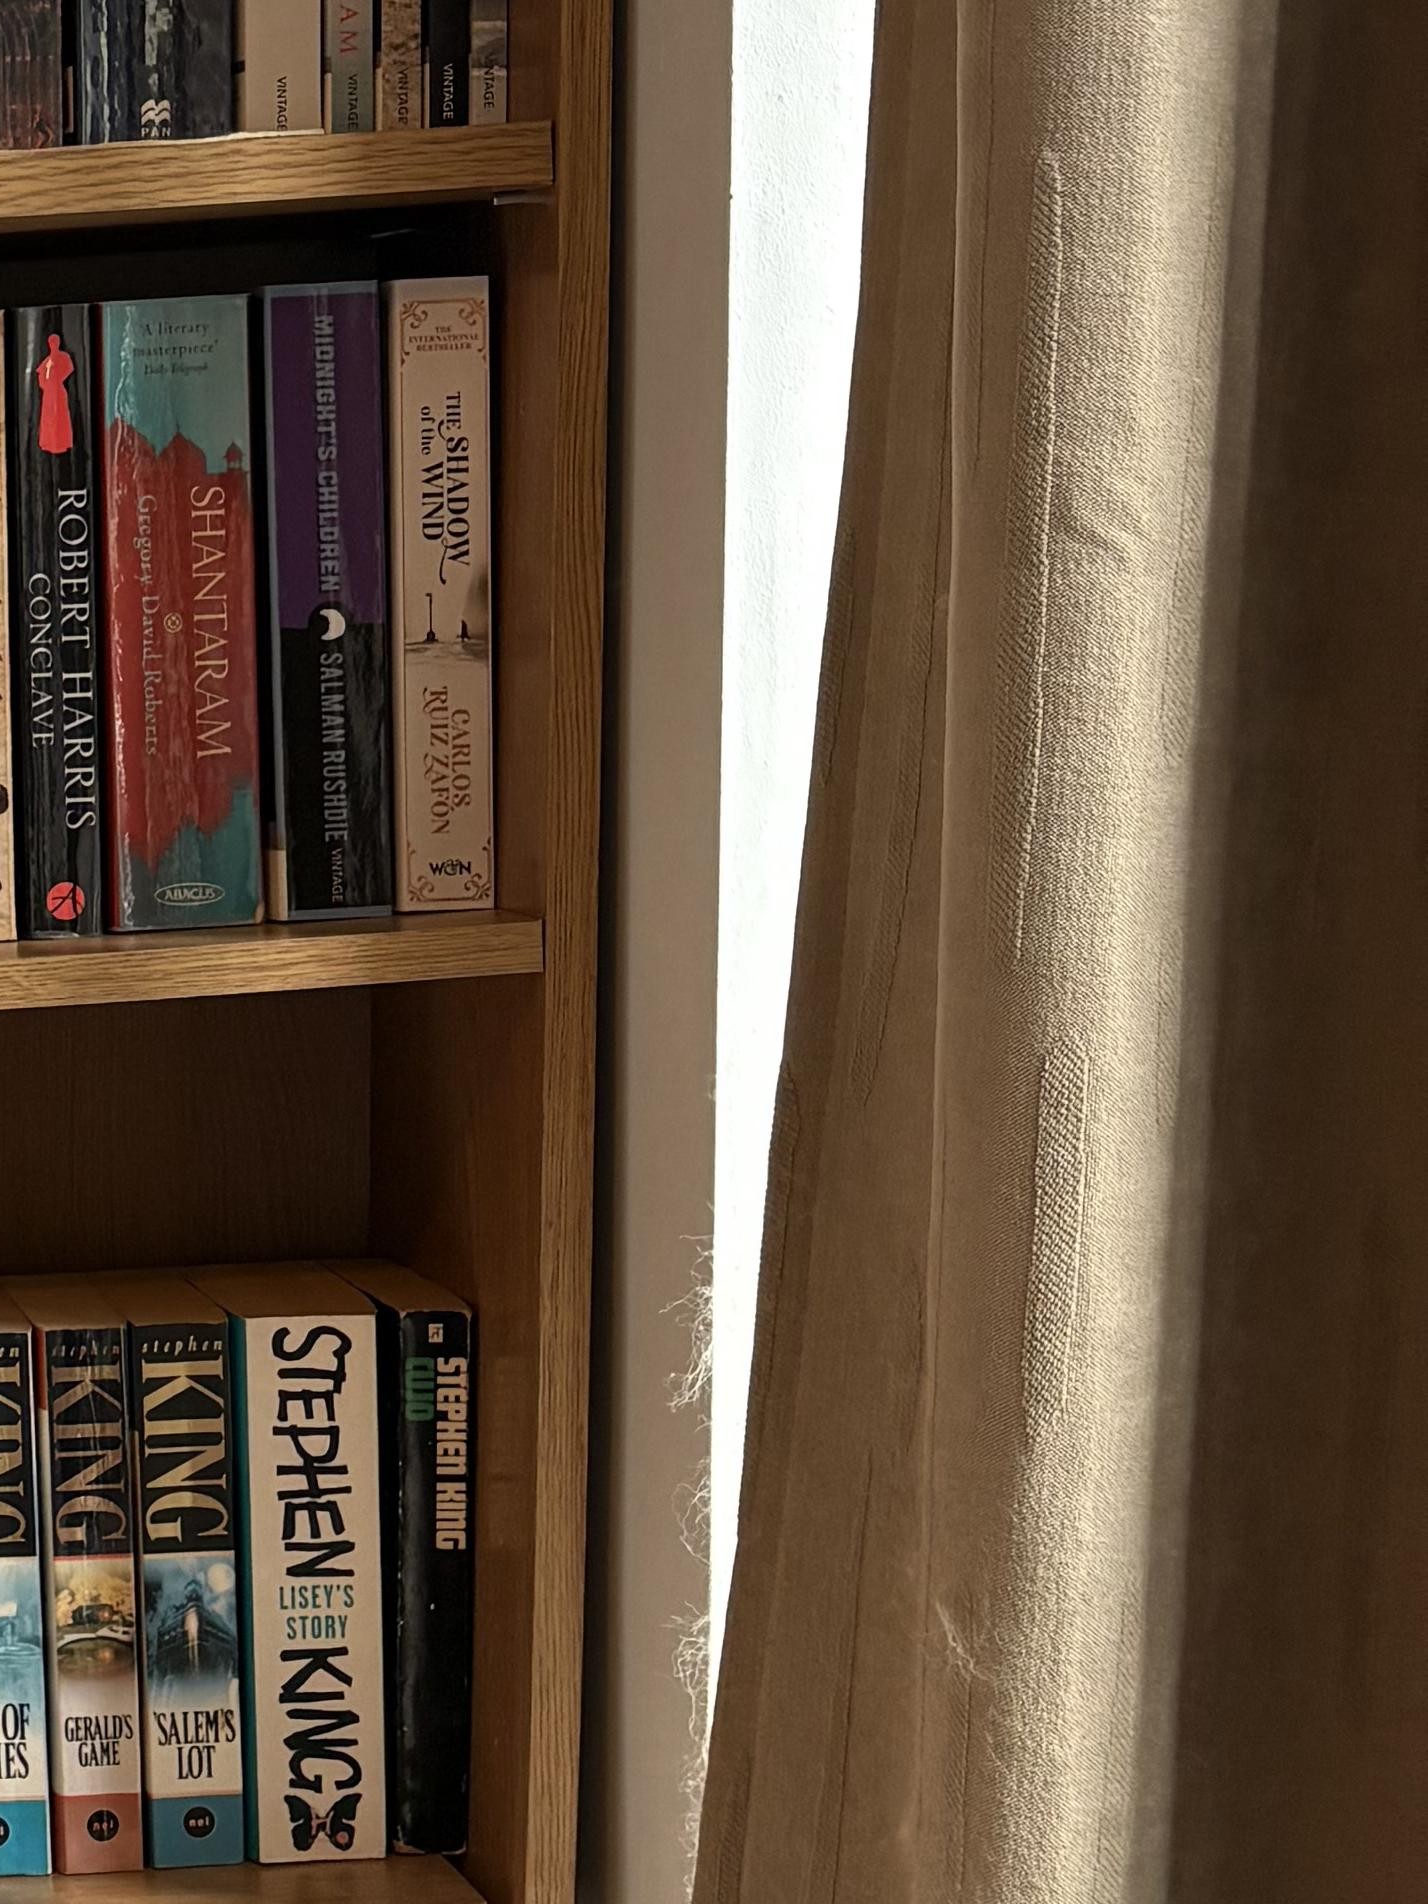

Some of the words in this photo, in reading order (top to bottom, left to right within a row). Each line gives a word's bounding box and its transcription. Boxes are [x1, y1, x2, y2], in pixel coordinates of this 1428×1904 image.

[190, 486, 231, 758] SHANTARAM
[279, 1584, 355, 1610] LISEY'S
[286, 1614, 348, 1641] STORY
[0, 1703, 30, 1740] OF
